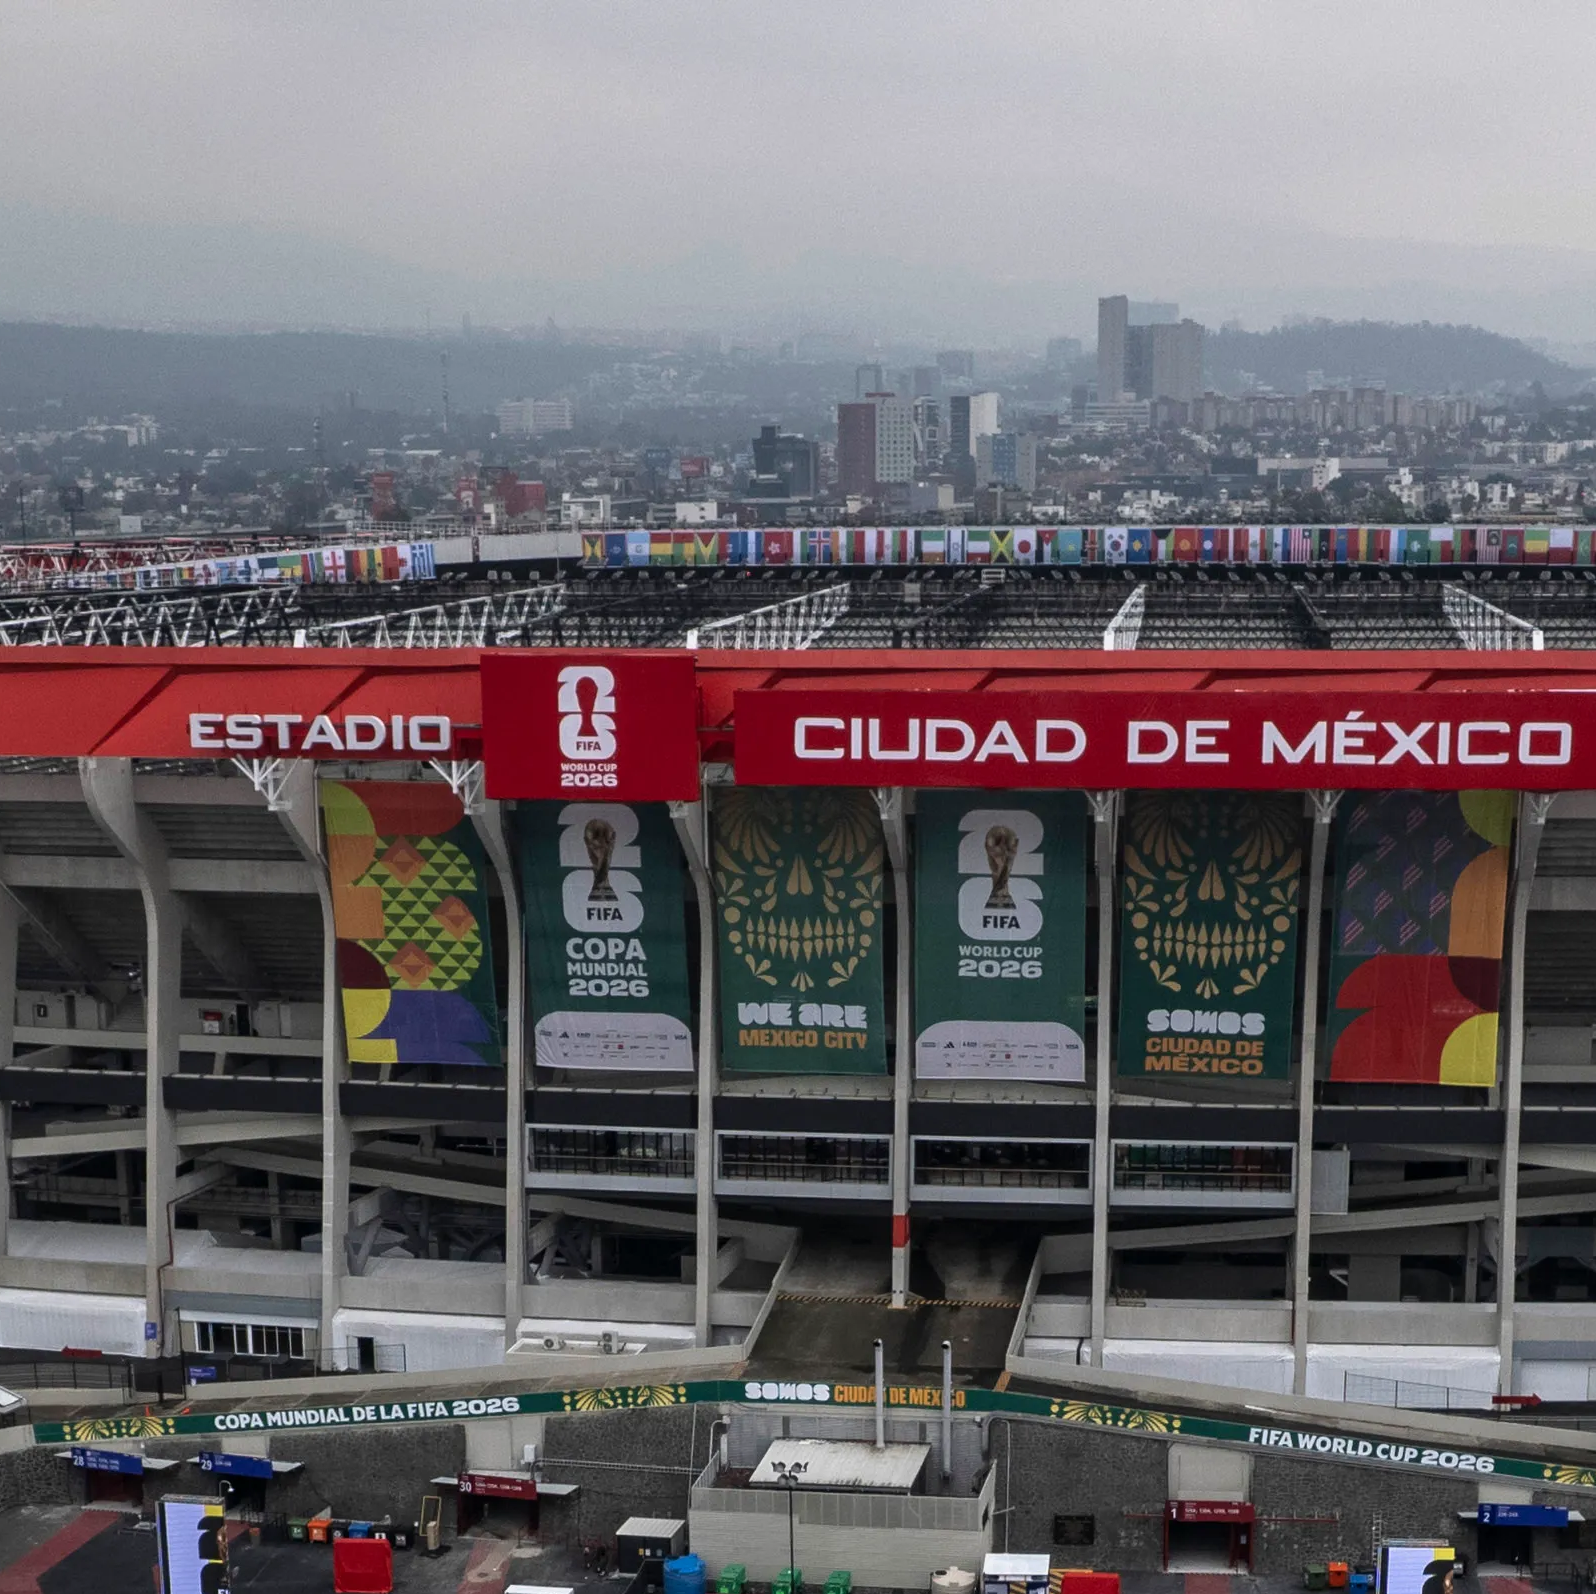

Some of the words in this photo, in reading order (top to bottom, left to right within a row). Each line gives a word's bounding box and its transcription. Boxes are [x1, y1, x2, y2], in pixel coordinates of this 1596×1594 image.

[189, 713, 450, 750] ESTADIO
[795, 716, 1087, 762] CIUDAD
[1127, 718, 1230, 763] DE
[1262, 710, 1573, 765] MÉXICO
[576, 741, 602, 751] FIFA
[560, 763, 596, 772] WORLD
[597, 763, 617, 772] CUP
[560, 773, 618, 787] 2026
[586, 907, 623, 921] FIFA
[982, 915, 1020, 929] FIFA
[565, 938, 647, 960] COPA
[958, 945, 1011, 958] WORLD
[1013, 946, 1043, 959] CUP
[567, 962, 647, 977] MUNDIAL
[958, 959, 1043, 979] 2026
[568, 979, 649, 997] 2026
[737, 1002, 792, 1026] WE
[1147, 1009, 1265, 1035] SOMOS
[739, 1029, 818, 1048] MEXICO
[824, 1031, 868, 1049] CITY
[1146, 1038, 1233, 1055] CIUDAD
[1236, 1041, 1264, 1056] DE
[1144, 1053, 1264, 1075] MÉXICO
[744, 1382, 830, 1401] SOMOS
[834, 1384, 886, 1403] CIUDA
[889, 1386, 907, 1405] DE
[909, 1386, 965, 1407] MÉXO
[214, 1412, 264, 1430] COPA
[266, 1407, 349, 1428] MUNDIAL
[352, 1405, 377, 1422] DE
[380, 1403, 405, 1420] LA
[406, 1401, 449, 1418] FIFA
[451, 1397, 520, 1415] 2026
[1249, 1428, 1293, 1447] FIFA
[1297, 1433, 1372, 1457] WORLD
[1375, 1444, 1418, 1462] CUP
[1420, 1450, 1496, 1473] 2026
[73, 1455, 85, 1466] 28
[201, 1459, 213, 1471] 29
[459, 1481, 472, 1492] 30
[1171, 1508, 1177, 1519] 1
[1483, 1512, 1490, 1522] 2
